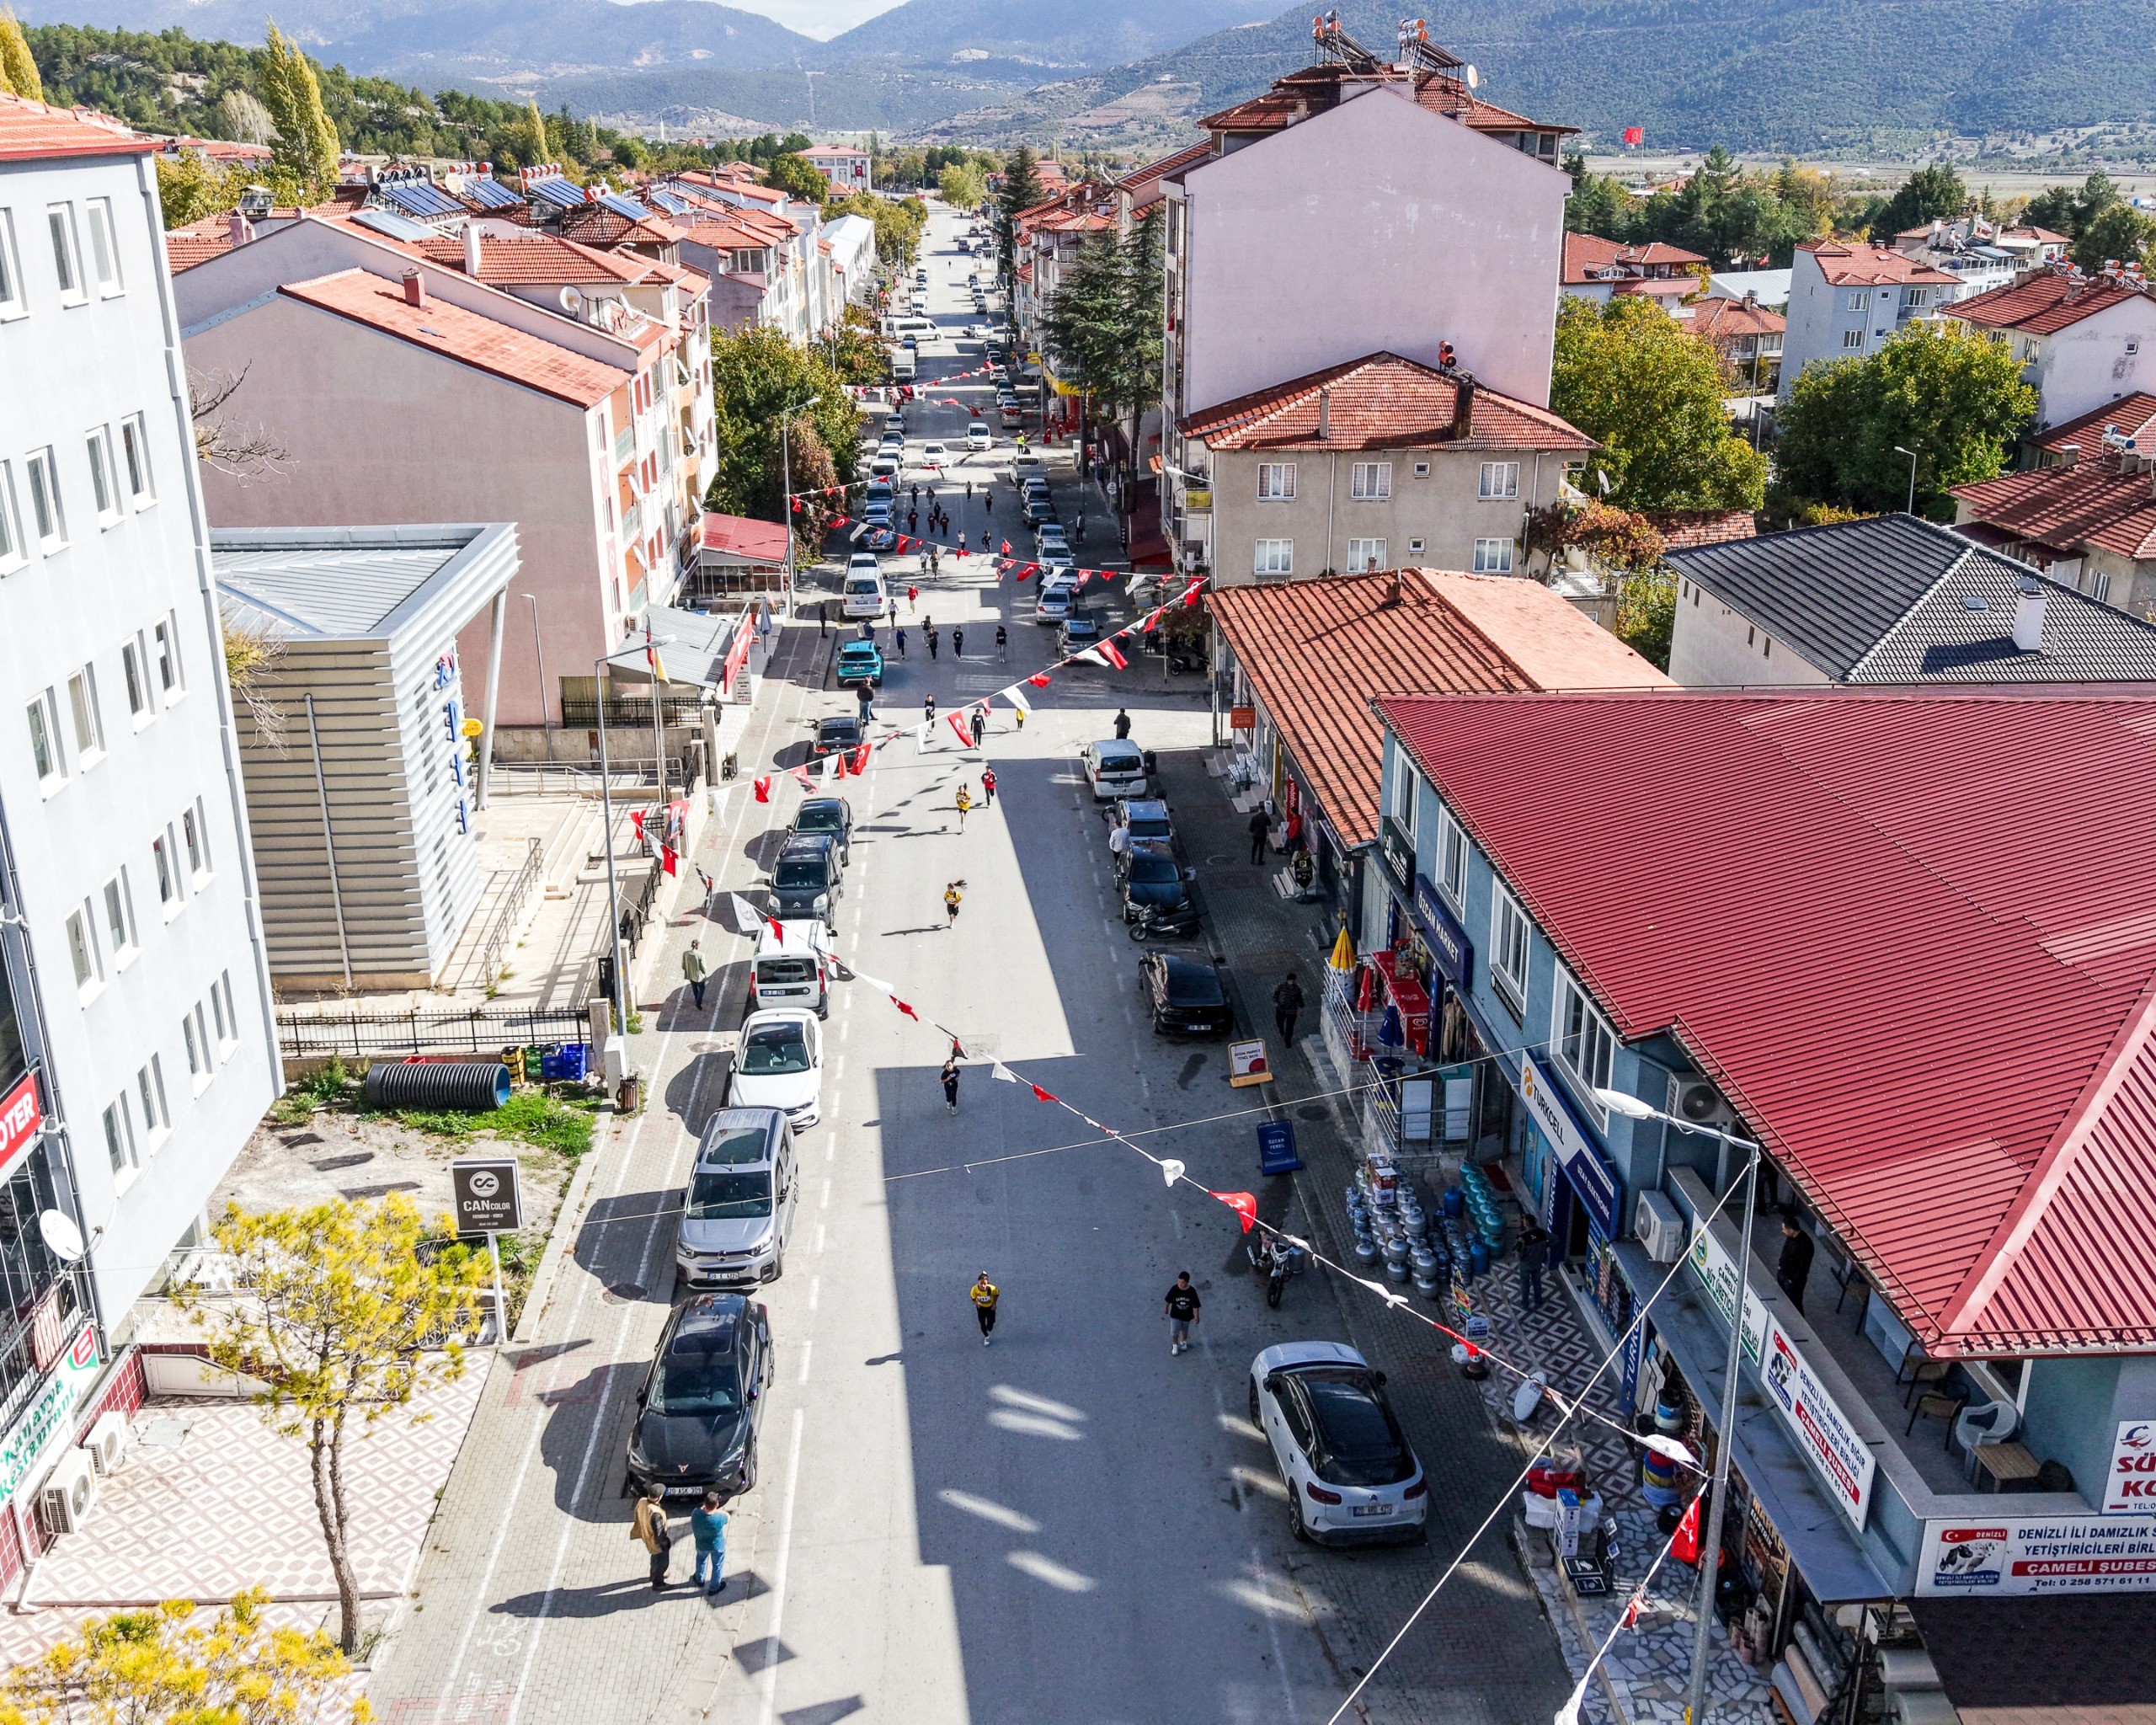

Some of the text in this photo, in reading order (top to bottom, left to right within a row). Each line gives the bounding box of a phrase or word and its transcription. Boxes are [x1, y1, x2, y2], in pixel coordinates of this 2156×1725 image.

[1418, 890, 1459, 964] ÖZCAN MARKET
[1533, 1083, 1565, 1146] TURKCELL
[1, 1379, 64, 1467] Kanarya
[1800, 1368, 1820, 1402] DENİZLİ
[1826, 1404, 1850, 1447] DAMIZLIK
[1851, 1440, 1866, 1470] SIĞIR
[1800, 1409, 1855, 1495] ÇAMELİ ŞUBESİ
[1840, 1445, 1860, 1481] BİRLİĞİ
[1976, 1530, 2006, 1539] DENİZLİ
[2018, 1525, 2067, 1540] DENİZLİ
[2070, 1525, 2086, 1539] İLİ
[2089, 1526, 2148, 1539] DAMIZLIK
[2025, 1541, 2125, 1557] YETİŞTİRİCİLERİ
[2027, 1562, 2094, 1576] ÇAMELİ
[2035, 1579, 2057, 1588] Tel:
[2070, 1578, 2091, 1587] 258
[2095, 1578, 2116, 1586] 571
[2119, 1577, 2133, 1585] 61
[2137, 1577, 2150, 1585] 11
